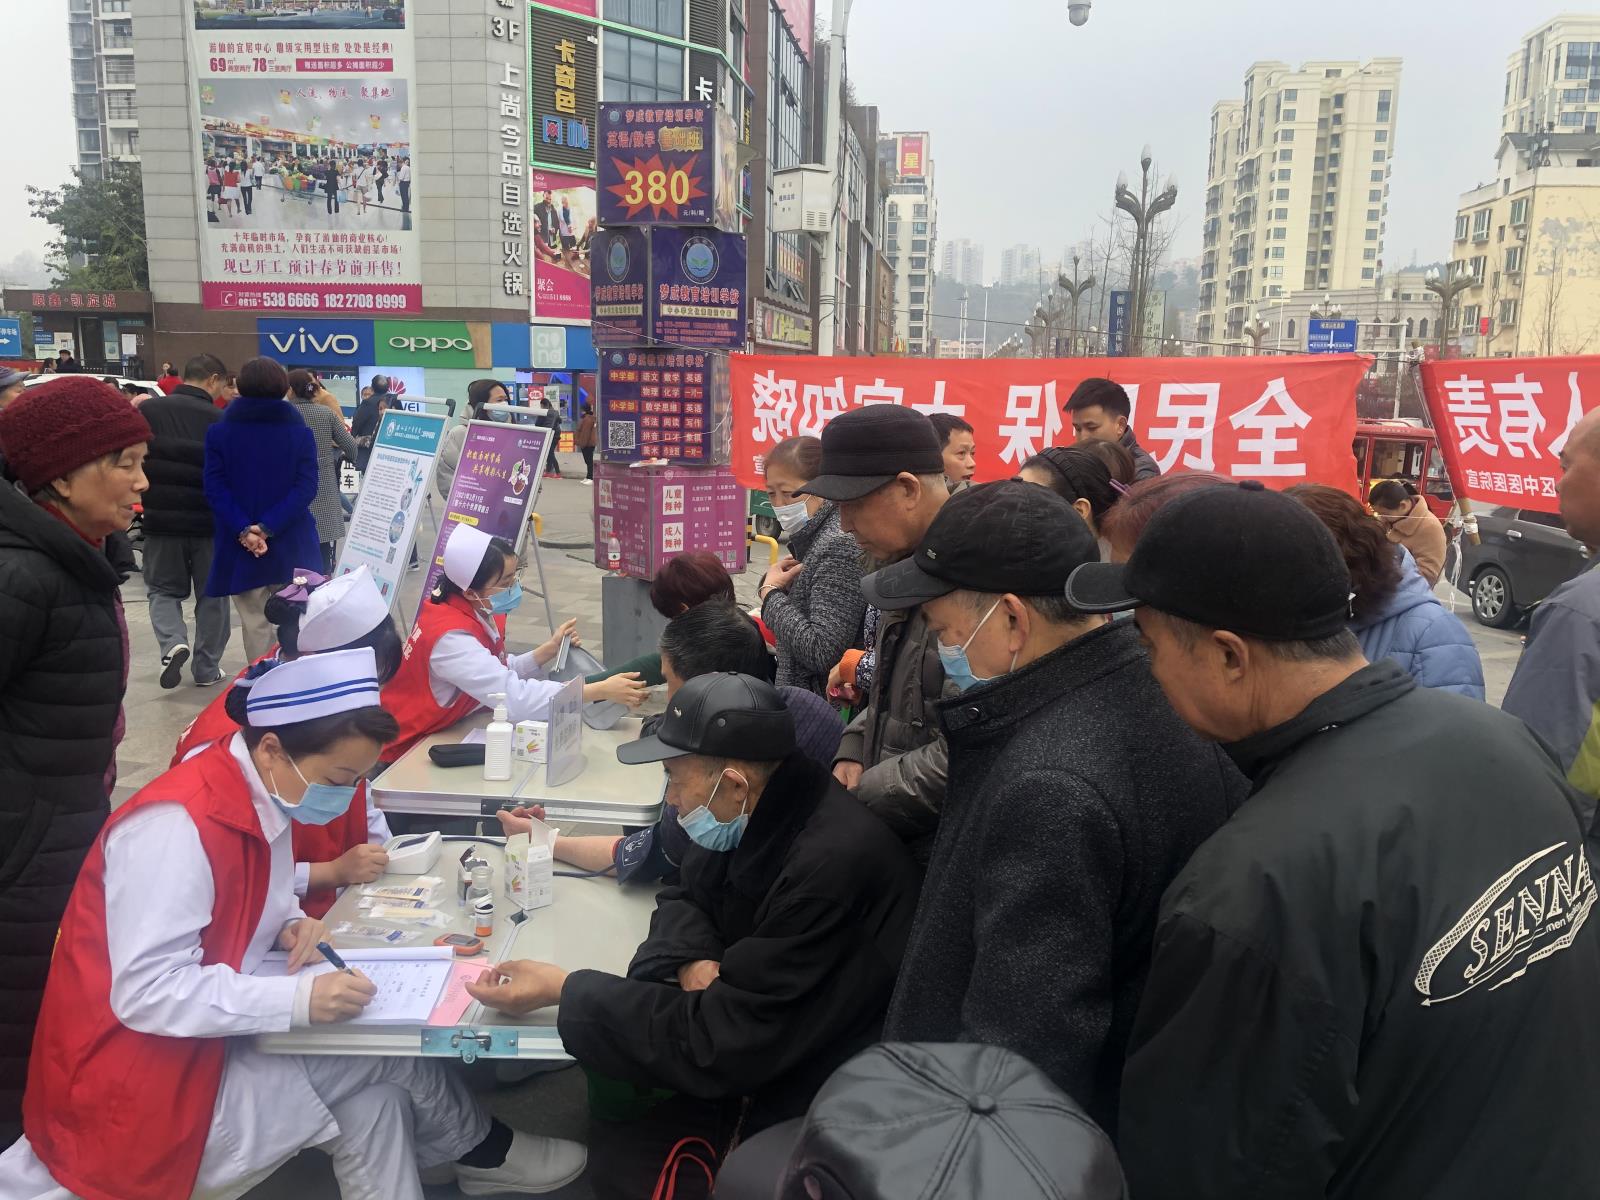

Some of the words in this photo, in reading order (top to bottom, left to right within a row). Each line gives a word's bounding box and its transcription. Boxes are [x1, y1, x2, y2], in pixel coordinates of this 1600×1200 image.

[492, 16, 520, 40] 3F
[210, 58, 226, 72] 69
[252, 58, 267, 72] 78
[624, 170, 690, 205] 380
[536, 278, 554, 292] 聚会
[262, 292, 286, 307] 538
[287, 292, 320, 308] 6666
[324, 294, 346, 308] 182
[346, 294, 374, 308] 2708
[376, 294, 406, 308] 8999
[270, 327, 359, 354] vivo
[388, 336, 473, 352] oppo
[663, 373, 680, 382] 数学
[686, 374, 702, 383] 英语
[642, 387, 659, 397] 物理
[663, 388, 680, 397] 化学
[686, 404, 702, 412] 英语
[666, 488, 682, 500] 儿童
[664, 526, 682, 537] 成人
[1464, 844, 1594, 978] SENNA
[1546, 916, 1566, 934] men
